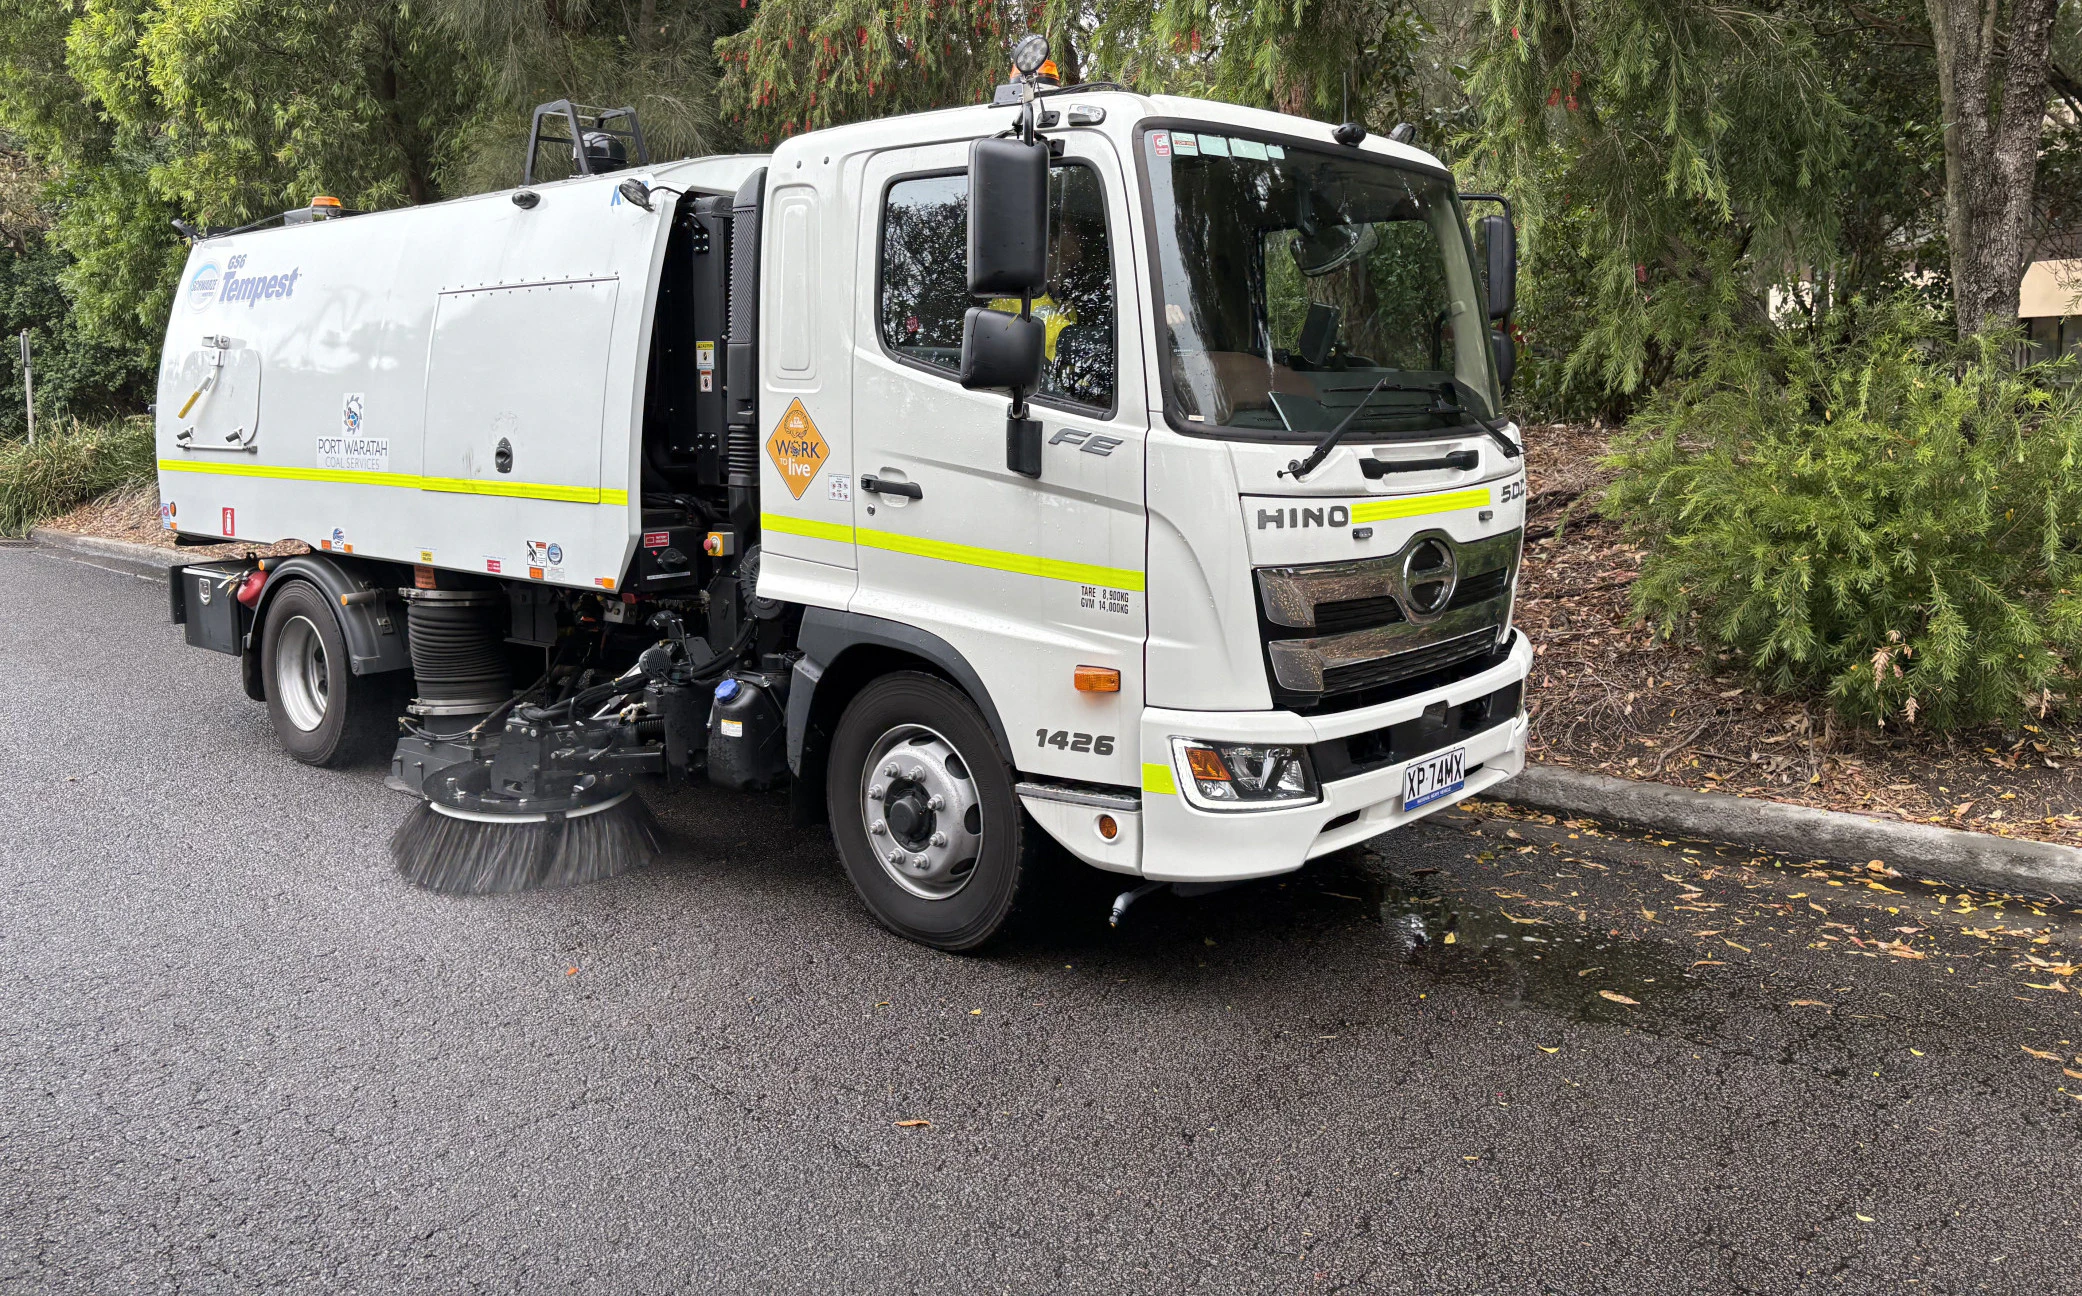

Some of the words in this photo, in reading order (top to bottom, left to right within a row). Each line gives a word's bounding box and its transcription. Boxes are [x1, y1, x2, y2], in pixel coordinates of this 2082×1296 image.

[228, 254, 247, 270] GS6
[219, 266, 299, 308] Tempest
[318, 439, 342, 454] PORT
[344, 440, 388, 456] WARATAH
[775, 440, 820, 459] WORK
[1048, 428, 1124, 456] FE
[325, 456, 344, 469] COAL
[346, 457, 380, 470] SERVICES
[780, 457, 788, 465] TO
[788, 457, 811, 477] live
[1257, 505, 1349, 530] HINO
[1081, 586, 1096, 598] TARE
[1080, 597, 1095, 609] GVM
[1036, 728, 1115, 756] 1426
